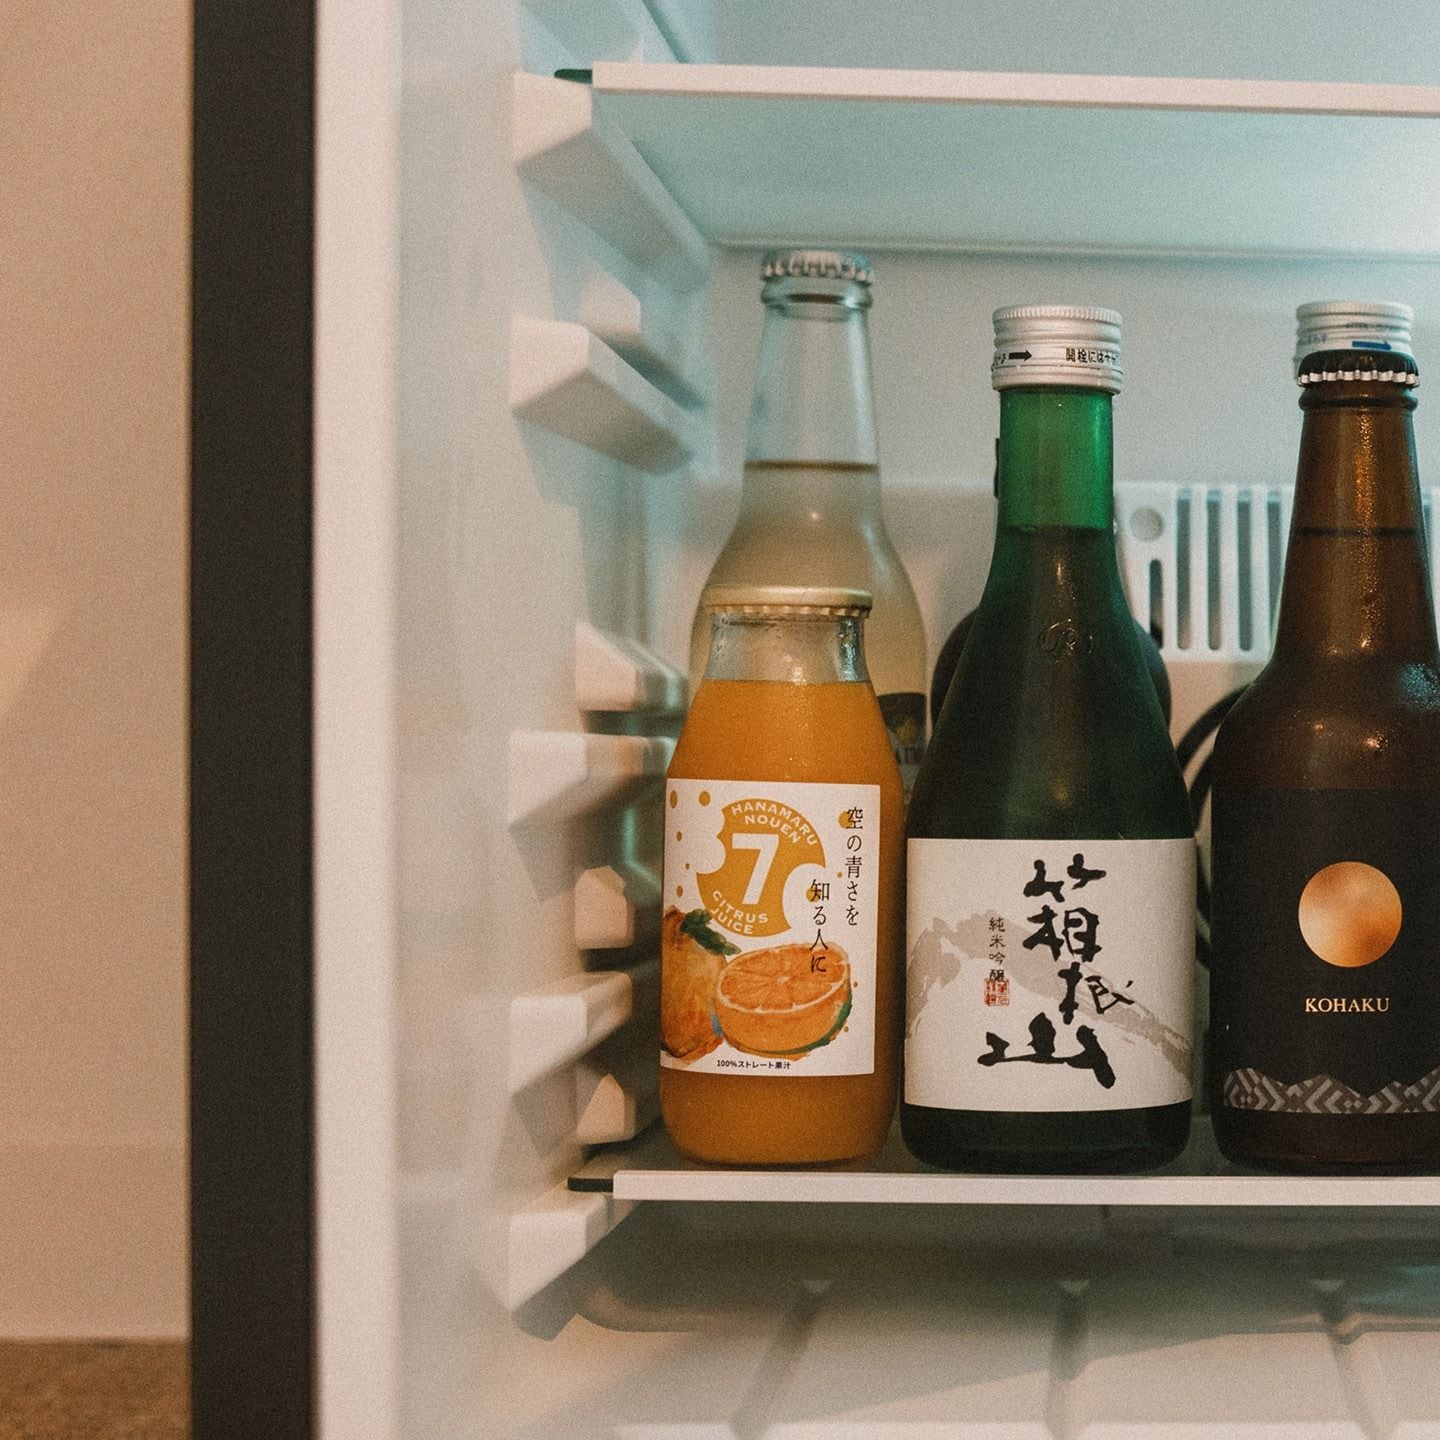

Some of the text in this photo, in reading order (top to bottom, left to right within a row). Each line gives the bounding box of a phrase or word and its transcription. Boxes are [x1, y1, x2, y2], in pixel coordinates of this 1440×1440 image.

[731, 802, 818, 846] HANAMARU
[744, 814, 801, 844] NOUEN
[731, 832, 779, 905] 7
[845, 806, 864, 926] 空の青さを
[710, 907, 754, 935] JUICE
[712, 890, 769, 923] CITRUS
[809, 878, 830, 974] 知る人に
[1304, 998, 1390, 1013] KOHAKU
